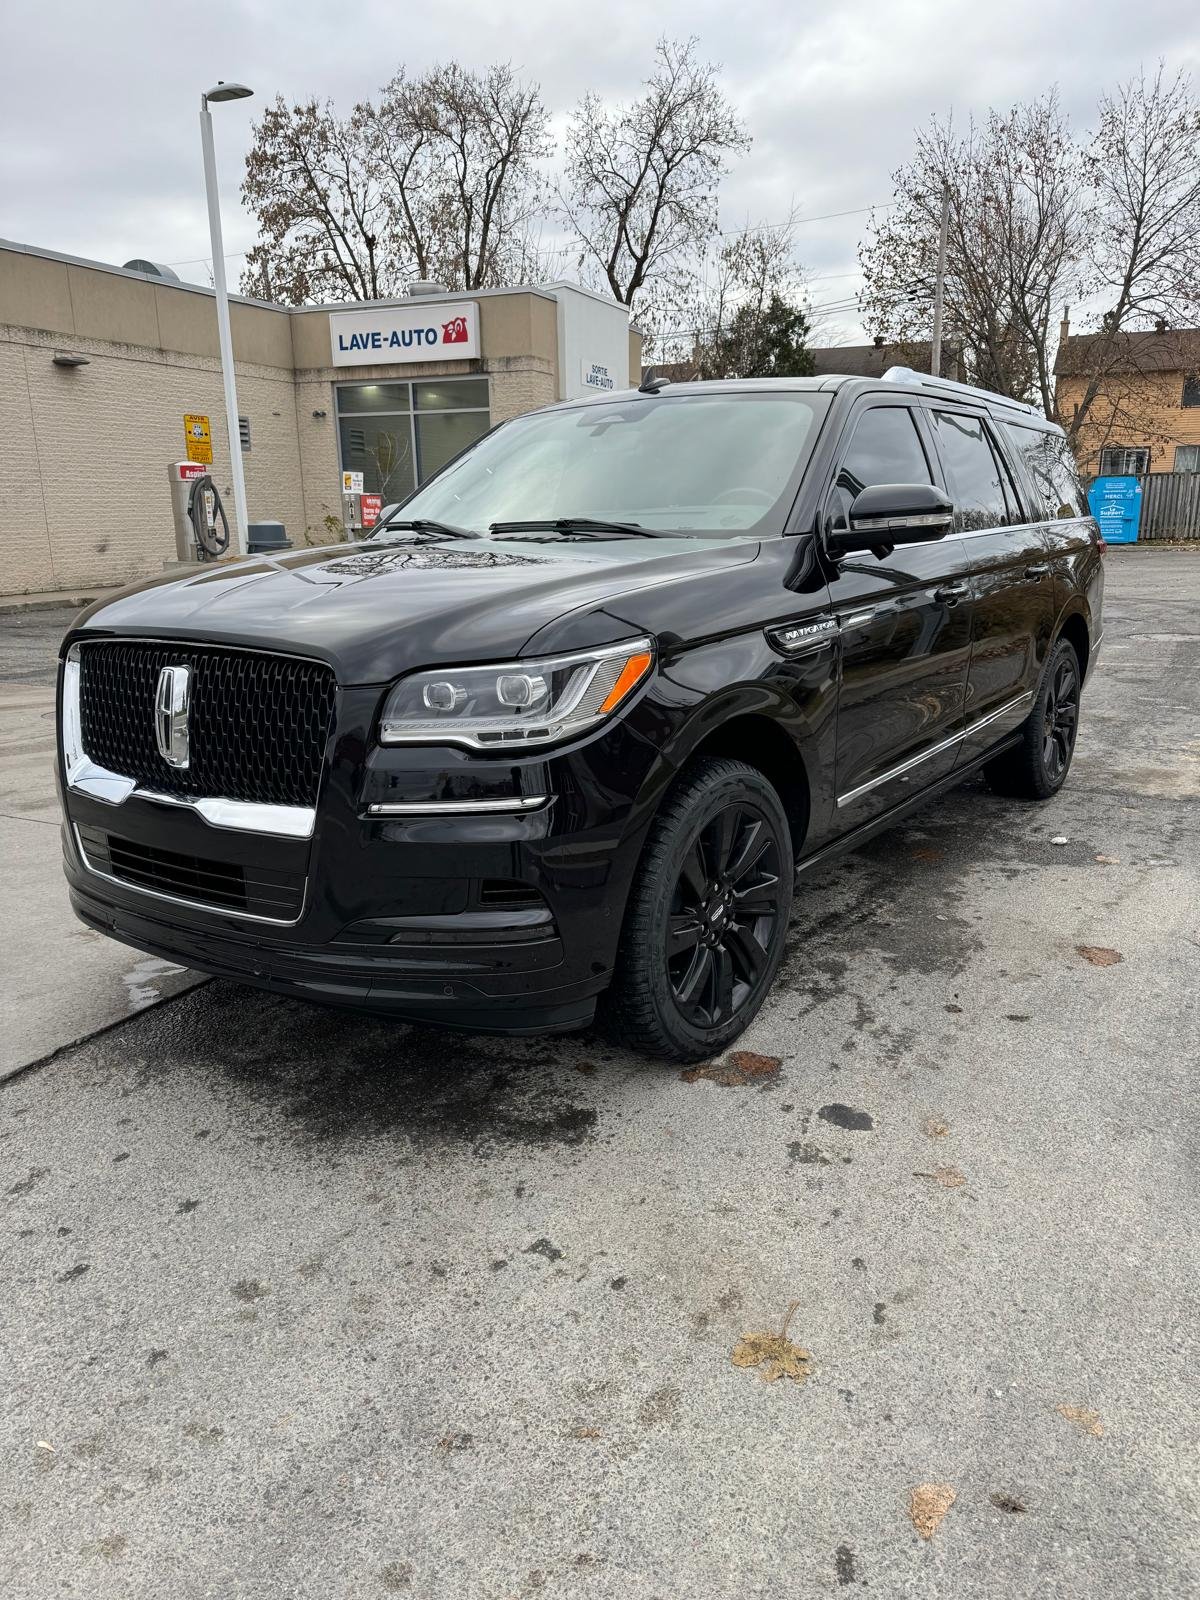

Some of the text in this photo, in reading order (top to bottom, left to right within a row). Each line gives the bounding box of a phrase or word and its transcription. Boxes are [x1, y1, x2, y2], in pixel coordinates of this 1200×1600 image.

[338, 328, 438, 351] LAVE-AUTO
[591, 364, 608, 377] SORTIE
[586, 372, 614, 390] LAVE-AUTO
[785, 620, 836, 640] NAVIGATOR
